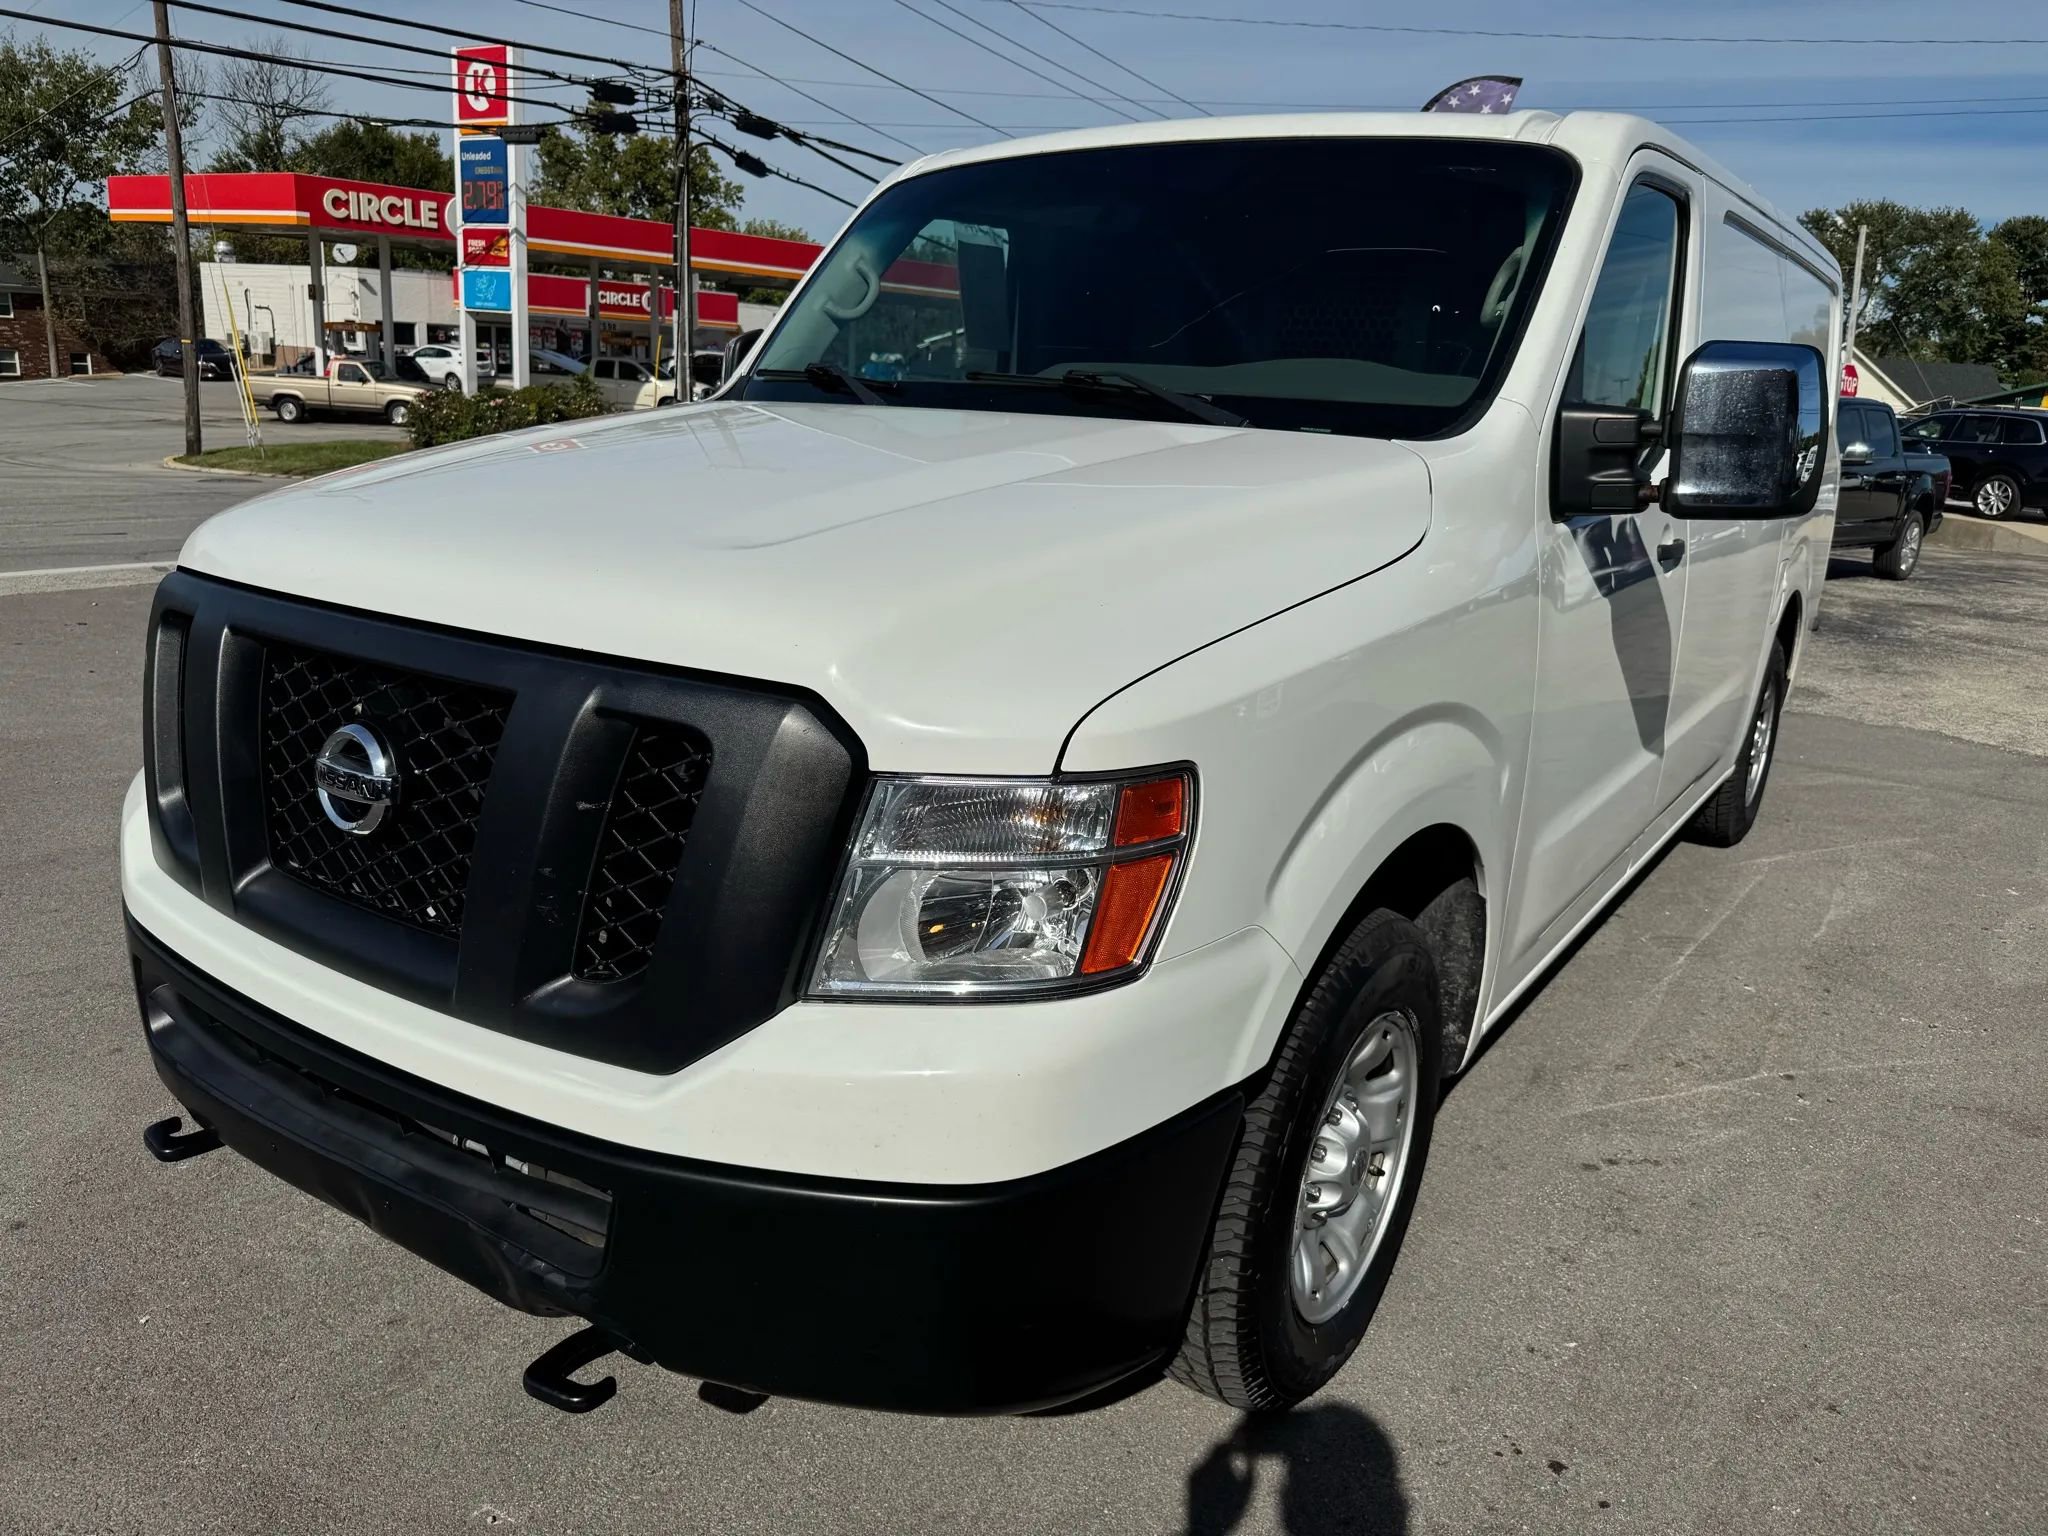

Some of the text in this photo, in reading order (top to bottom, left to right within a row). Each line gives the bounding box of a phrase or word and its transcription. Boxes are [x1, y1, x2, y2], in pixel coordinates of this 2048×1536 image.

[473, 68, 491, 101] K
[461, 151, 491, 161] Unleaded
[323, 188, 438, 229] CIRCLE
[598, 290, 641, 308] CIRCLE
[316, 764, 377, 799] NISSAN
